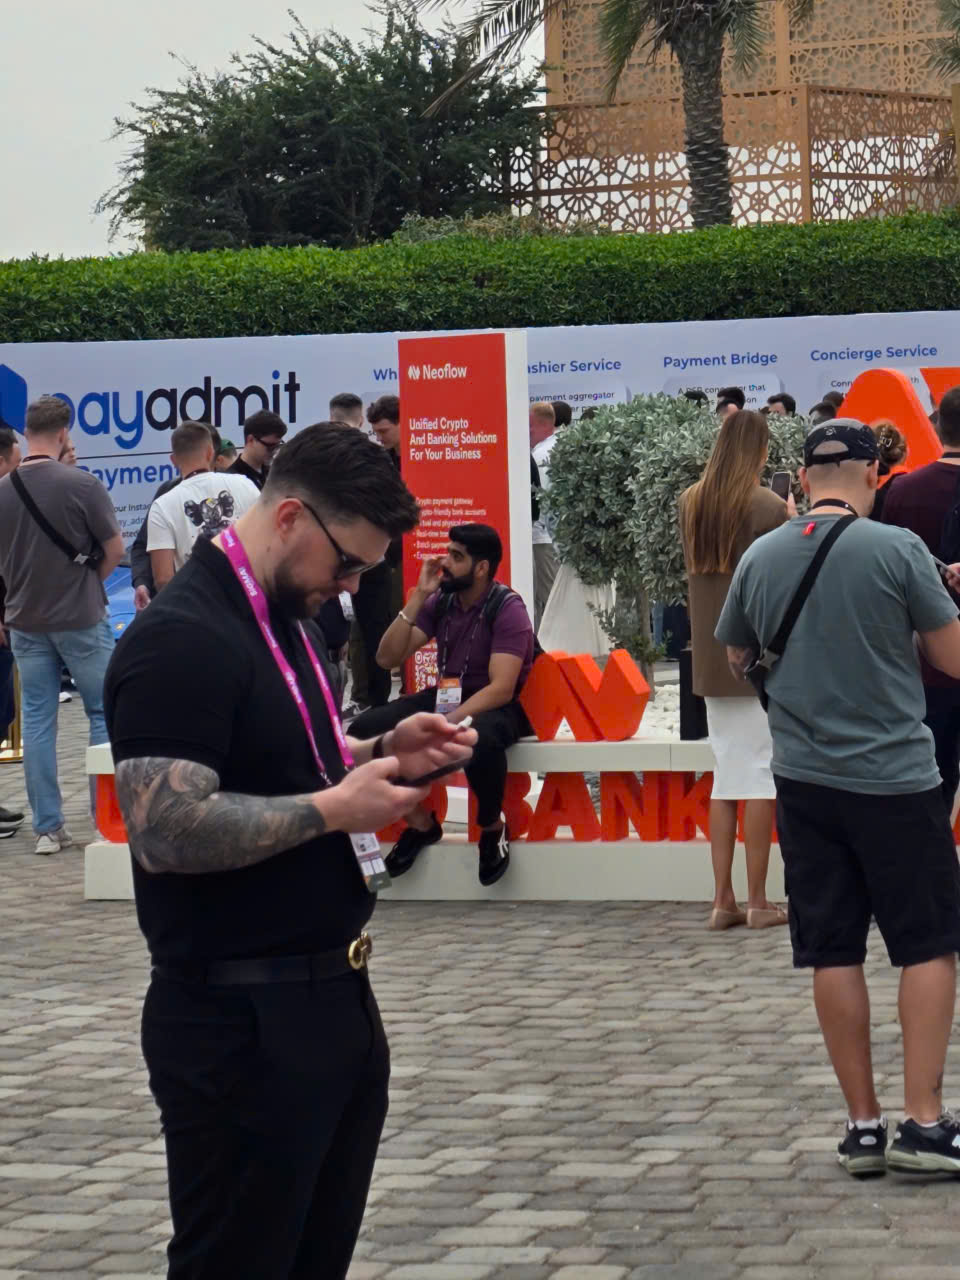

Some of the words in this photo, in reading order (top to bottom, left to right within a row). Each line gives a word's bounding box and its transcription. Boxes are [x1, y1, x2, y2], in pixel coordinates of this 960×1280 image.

[810, 347, 882, 362] Concierge
[886, 344, 938, 358] Service
[570, 358, 622, 372] Service
[663, 355, 727, 370] Payment
[730, 351, 778, 366] Bridge
[422, 363, 467, 380] Neoflow
[748, 384, 766, 392] that
[568, 391, 614, 401] aggregator
[409, 418, 438, 430] Unified
[440, 417, 469, 431] Crypto
[409, 433, 426, 445] And
[427, 432, 459, 447] Banking
[461, 431, 497, 444] Solutions
[409, 449, 423, 461] For
[424, 448, 443, 460] Your
[445, 447, 481, 460] Business
